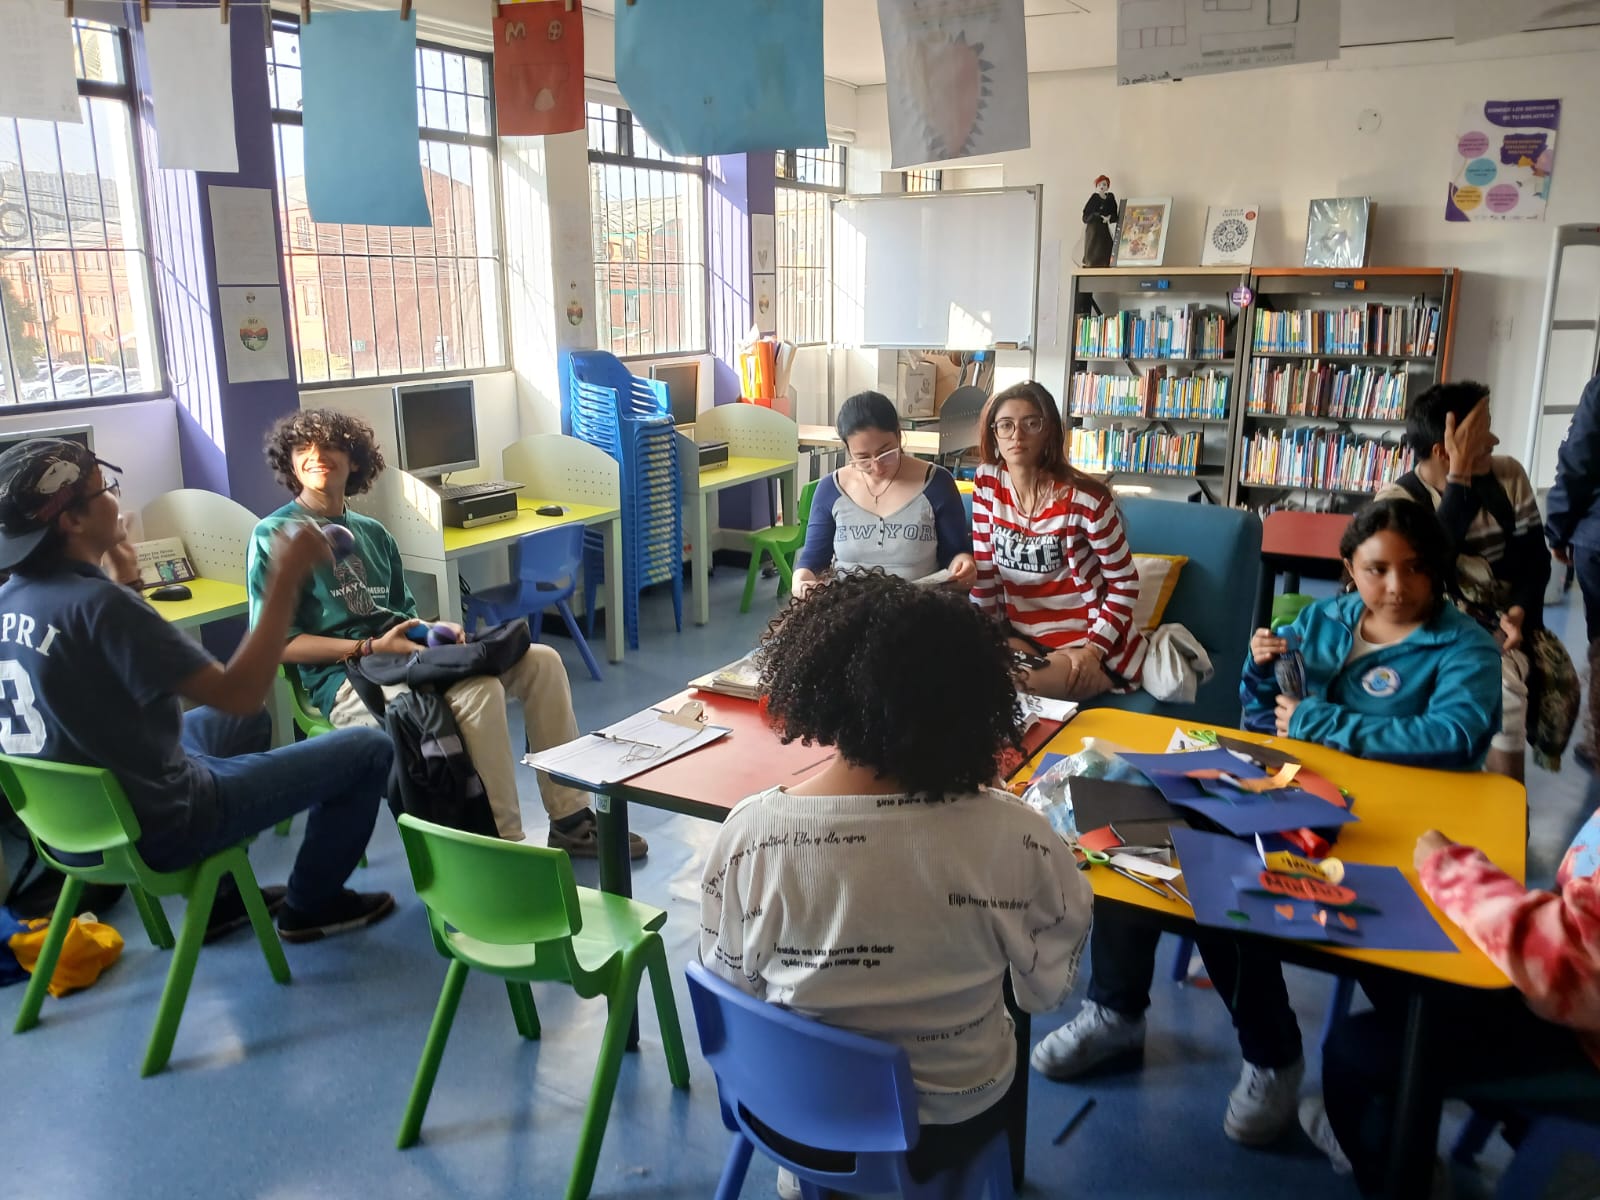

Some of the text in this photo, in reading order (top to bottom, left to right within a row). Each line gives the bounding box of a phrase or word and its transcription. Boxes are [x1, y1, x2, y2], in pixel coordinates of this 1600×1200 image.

[836, 523, 936, 541] EW YOR
[829, 945, 854, 957] forma
[857, 943, 869, 953] de
[870, 943, 895, 953] decir
[863, 958, 880, 968] que
